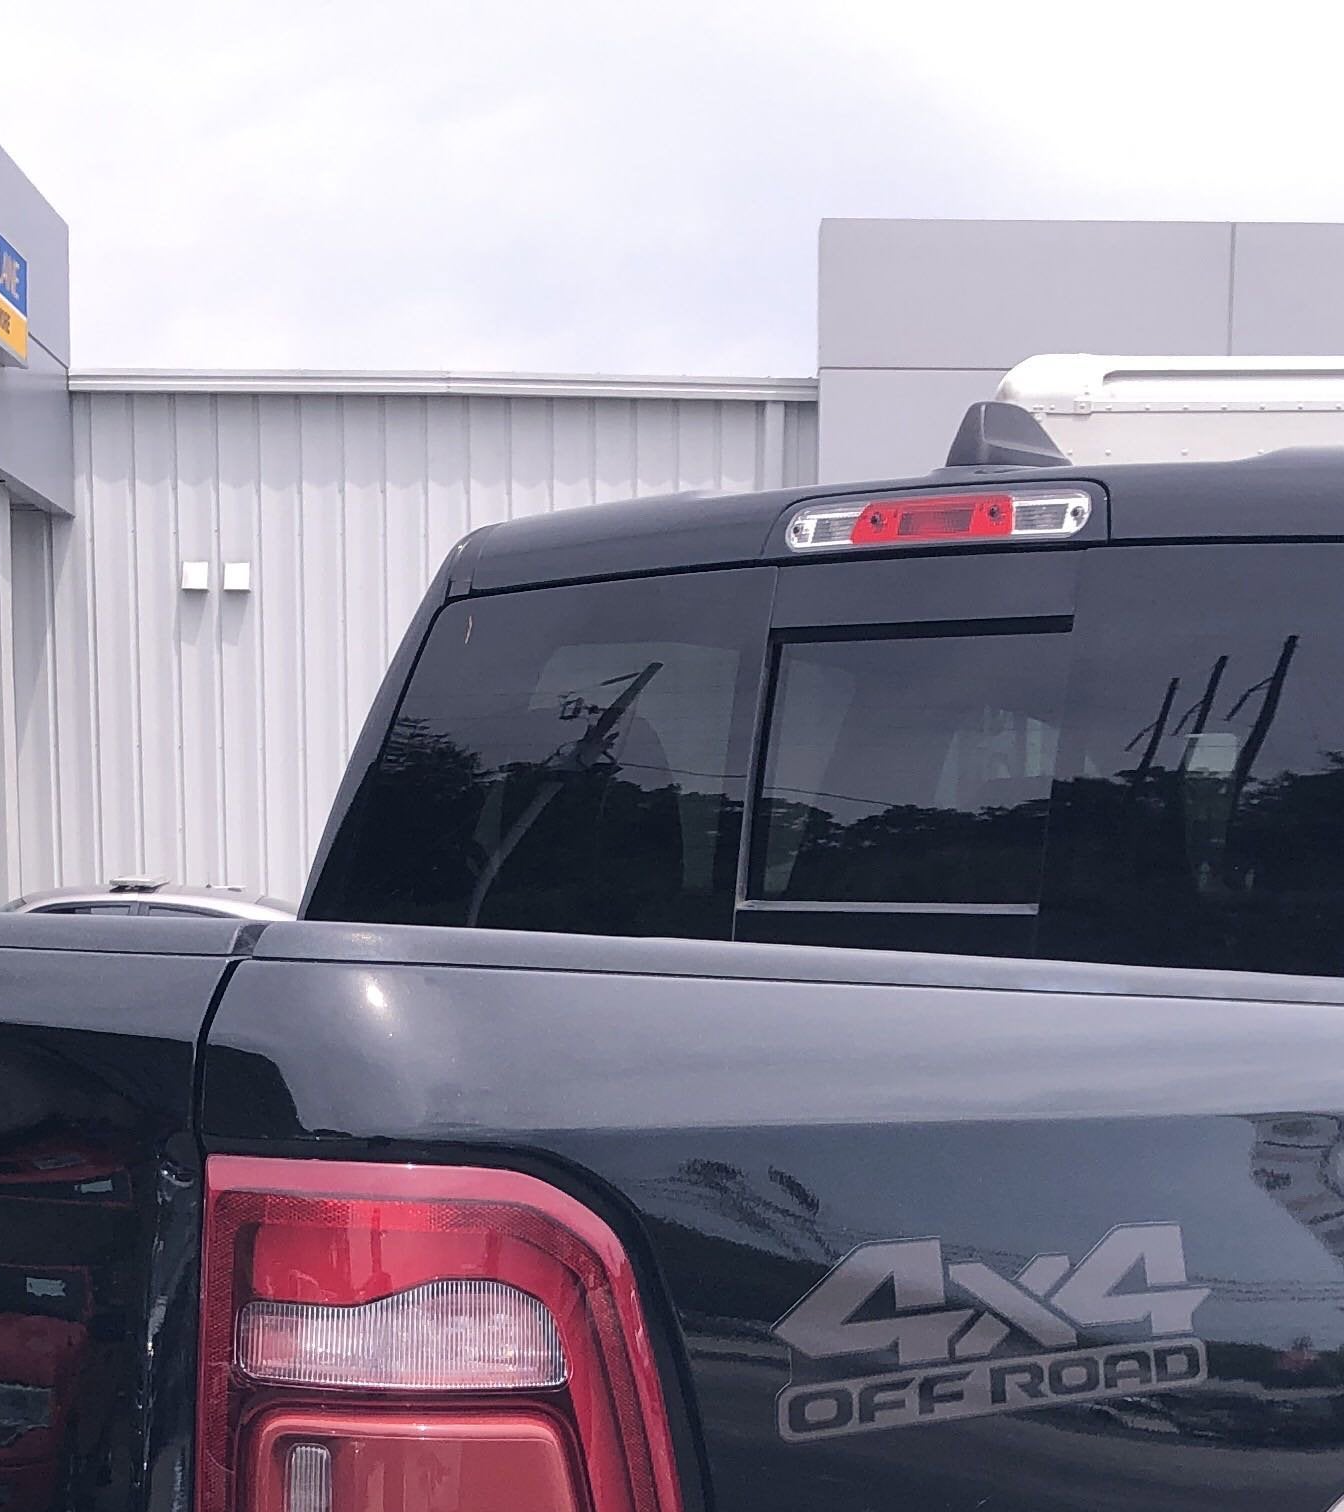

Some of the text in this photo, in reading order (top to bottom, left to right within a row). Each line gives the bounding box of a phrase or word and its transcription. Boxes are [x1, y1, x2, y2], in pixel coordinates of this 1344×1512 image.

[771, 1221, 1212, 1365] 4x4
[788, 1344, 1201, 1432] OFF ROAD
